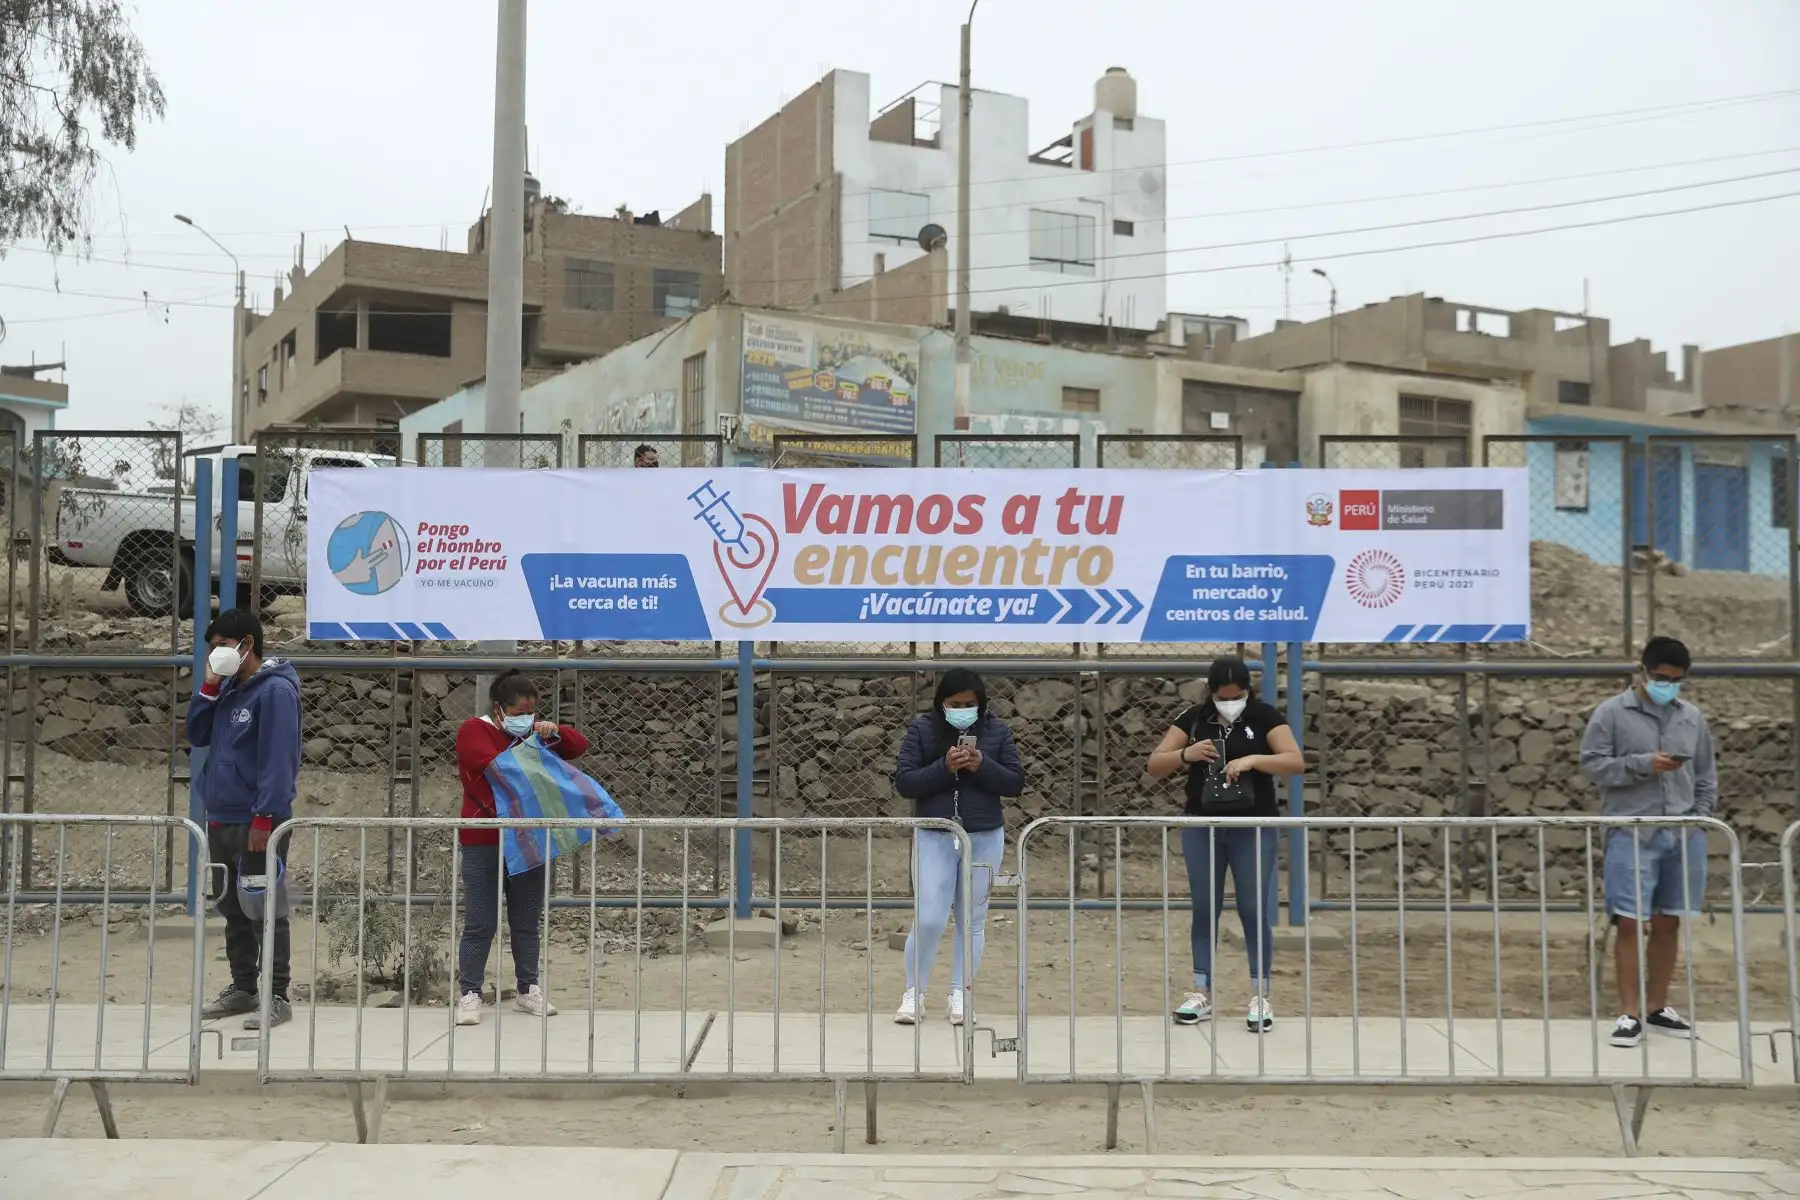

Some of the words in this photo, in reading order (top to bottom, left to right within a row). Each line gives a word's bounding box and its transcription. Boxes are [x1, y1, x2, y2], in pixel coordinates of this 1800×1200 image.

[782, 483, 985, 536] Vamos
[1001, 494, 1041, 535] a
[1055, 487, 1125, 536] tu
[1344, 503, 1377, 516] PERÚ
[1387, 504, 1435, 514] Ministerio
[1387, 515, 1399, 524] de
[1400, 515, 1428, 524] Salud
[417, 522, 469, 538] Pongo
[416, 539, 433, 554] el
[436, 539, 502, 554] hombro
[415, 557, 447, 574] por
[449, 555, 465, 571] el
[468, 554, 507, 571] Perú
[793, 538, 1115, 587] encuentro
[1185, 563, 1207, 579] En
[1209, 564, 1229, 579] tu
[1231, 562, 1289, 581] barrio,
[1413, 568, 1500, 578] BICENTENARIO
[420, 579, 434, 588] YO
[437, 579, 451, 588] ME
[453, 579, 495, 588] VACUNO
[549, 573, 574, 591] ¡La
[576, 576, 638, 589] vacuna
[641, 573, 678, 589] más
[1413, 578, 1445, 589] PERÚ
[1448, 580, 1474, 589] 2021
[1192, 584, 1269, 600] mercado
[1270, 588, 1283, 603] y
[568, 598, 614, 610] cerca
[617, 594, 639, 610] de
[641, 594, 659, 610] ti!
[859, 592, 993, 620] ¡Vacúnate
[994, 593, 1037, 621] ya!
[1165, 607, 1231, 621] centros
[1232, 605, 1256, 621] de
[1258, 605, 1309, 621] salud.
